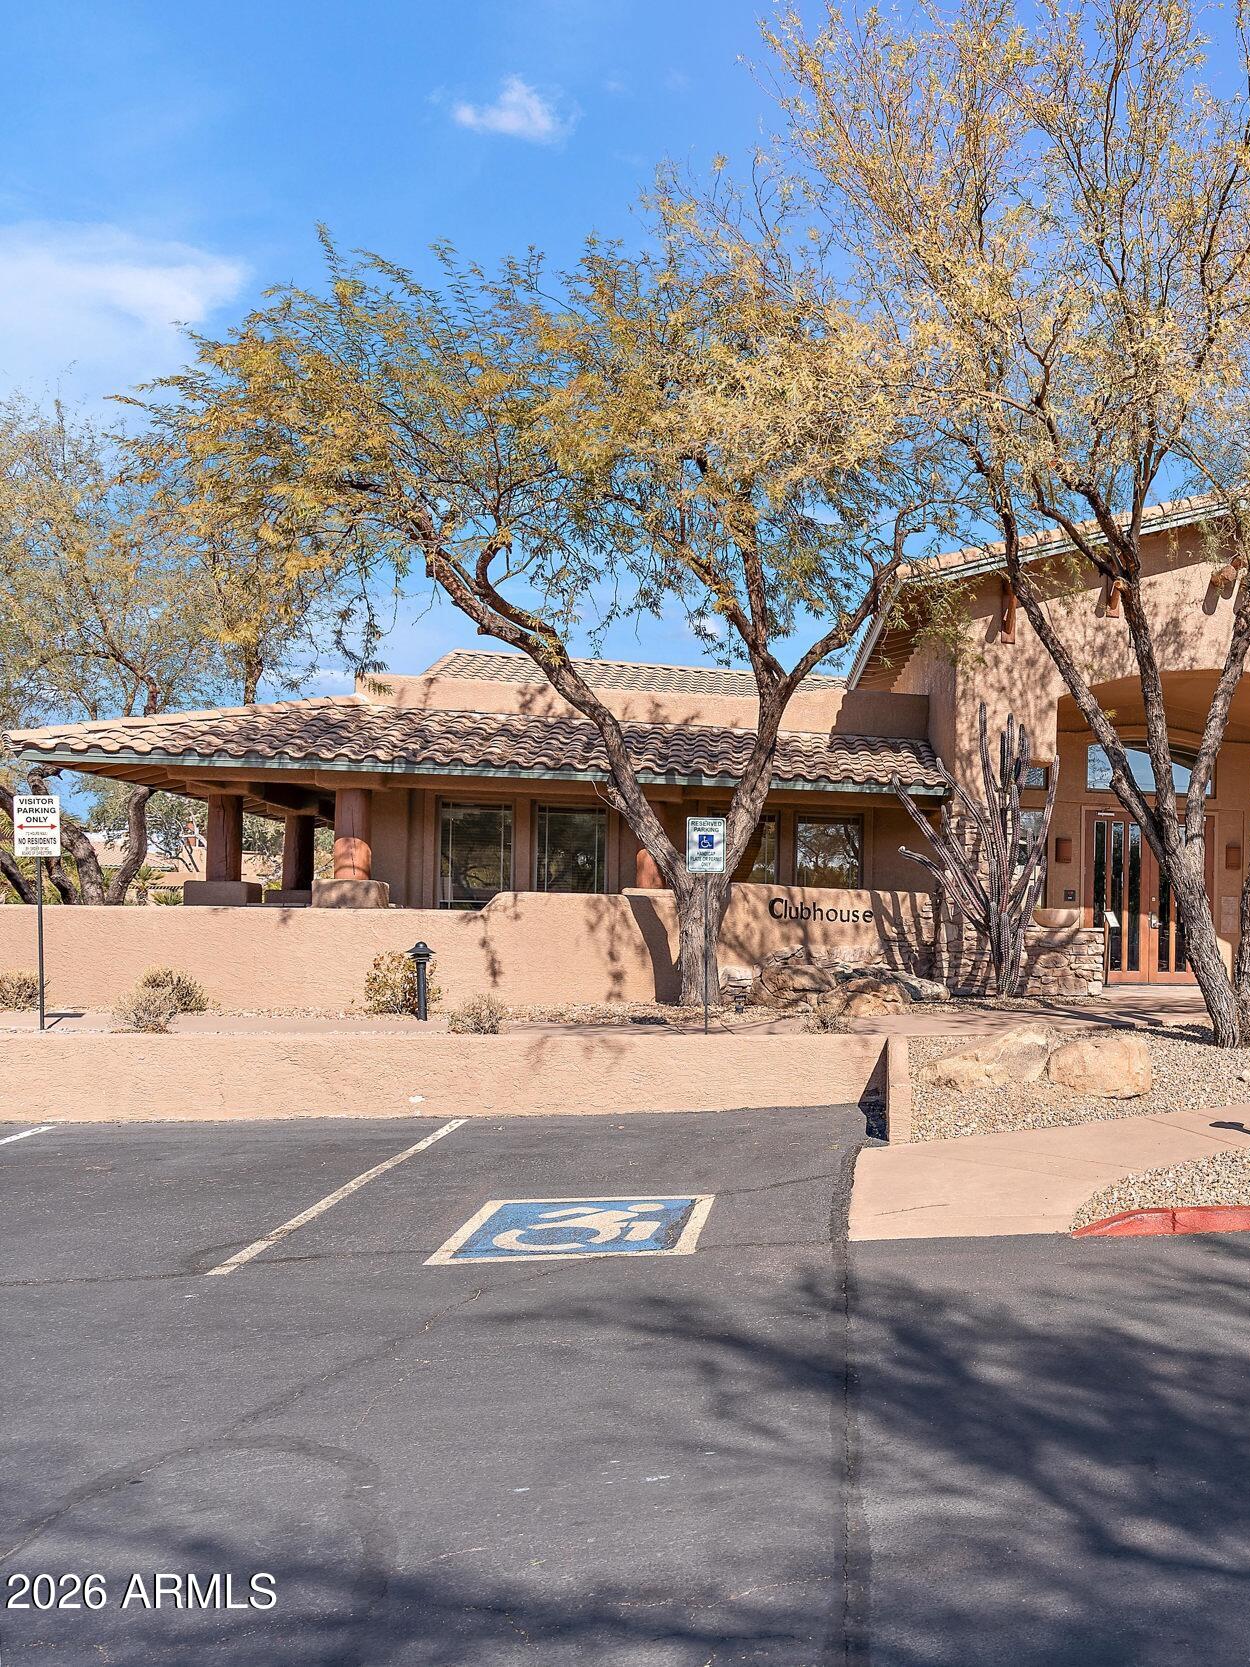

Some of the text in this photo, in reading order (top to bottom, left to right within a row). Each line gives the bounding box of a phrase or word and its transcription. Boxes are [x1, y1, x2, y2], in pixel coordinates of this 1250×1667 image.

[18, 837, 57, 845] NO RESIDENTS
[768, 897, 874, 923] Clubhouse
